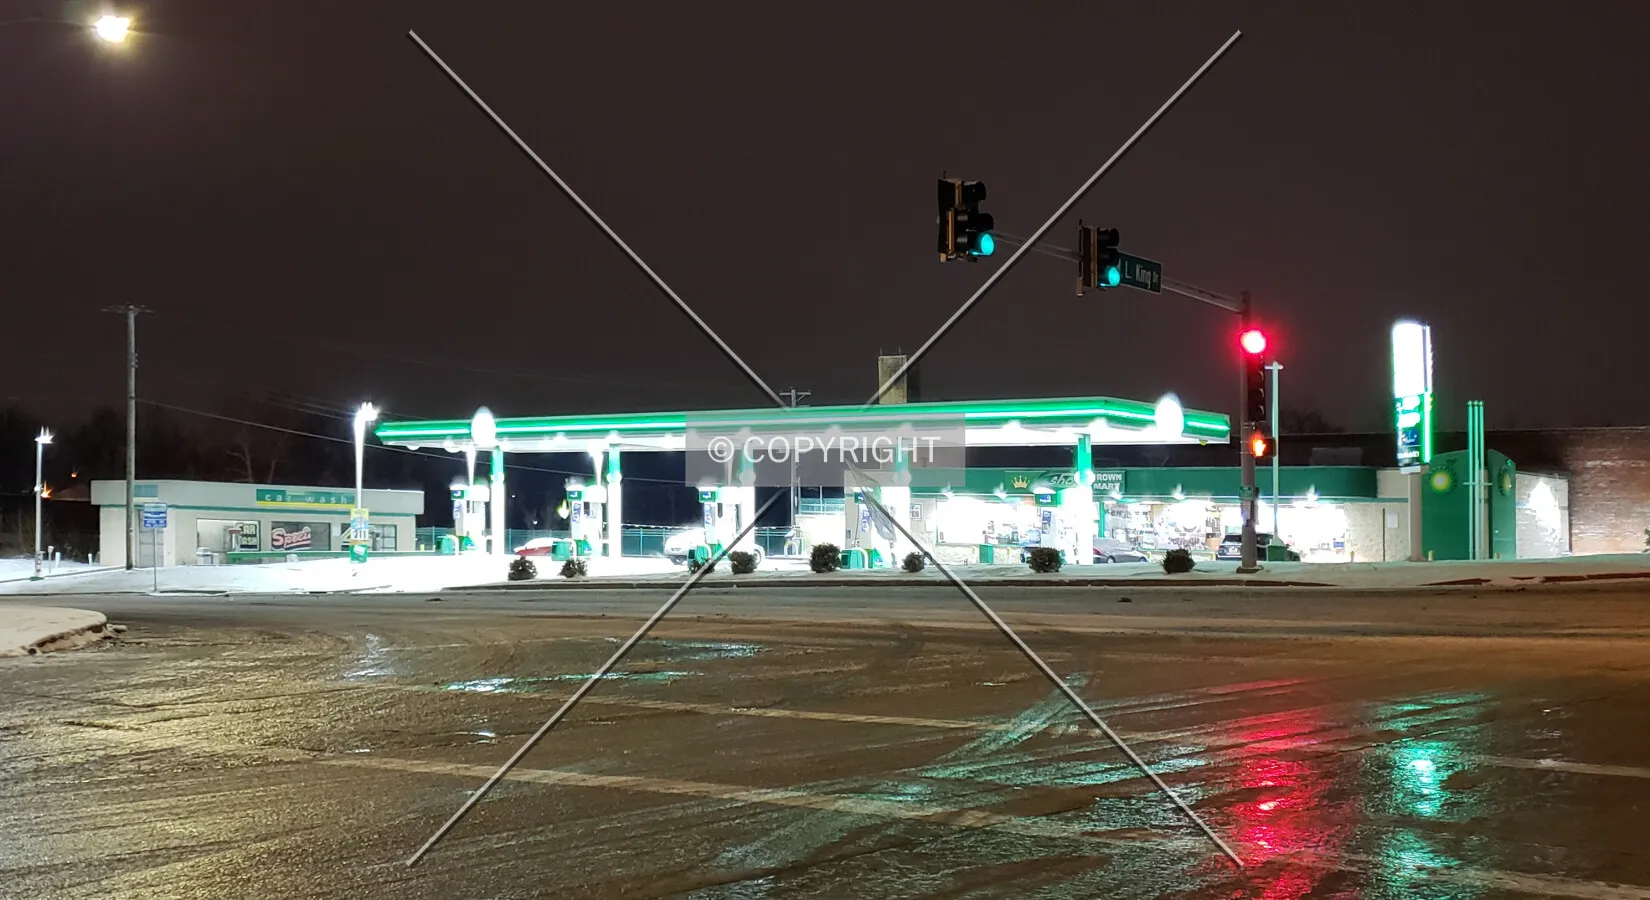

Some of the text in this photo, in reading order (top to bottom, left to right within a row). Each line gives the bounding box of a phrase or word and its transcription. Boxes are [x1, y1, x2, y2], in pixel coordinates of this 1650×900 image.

[1136, 264, 1151, 289] King
[1094, 473, 1122, 481] ROWN
[1093, 482, 1120, 491] MART
[265, 493, 347, 504] car wash
